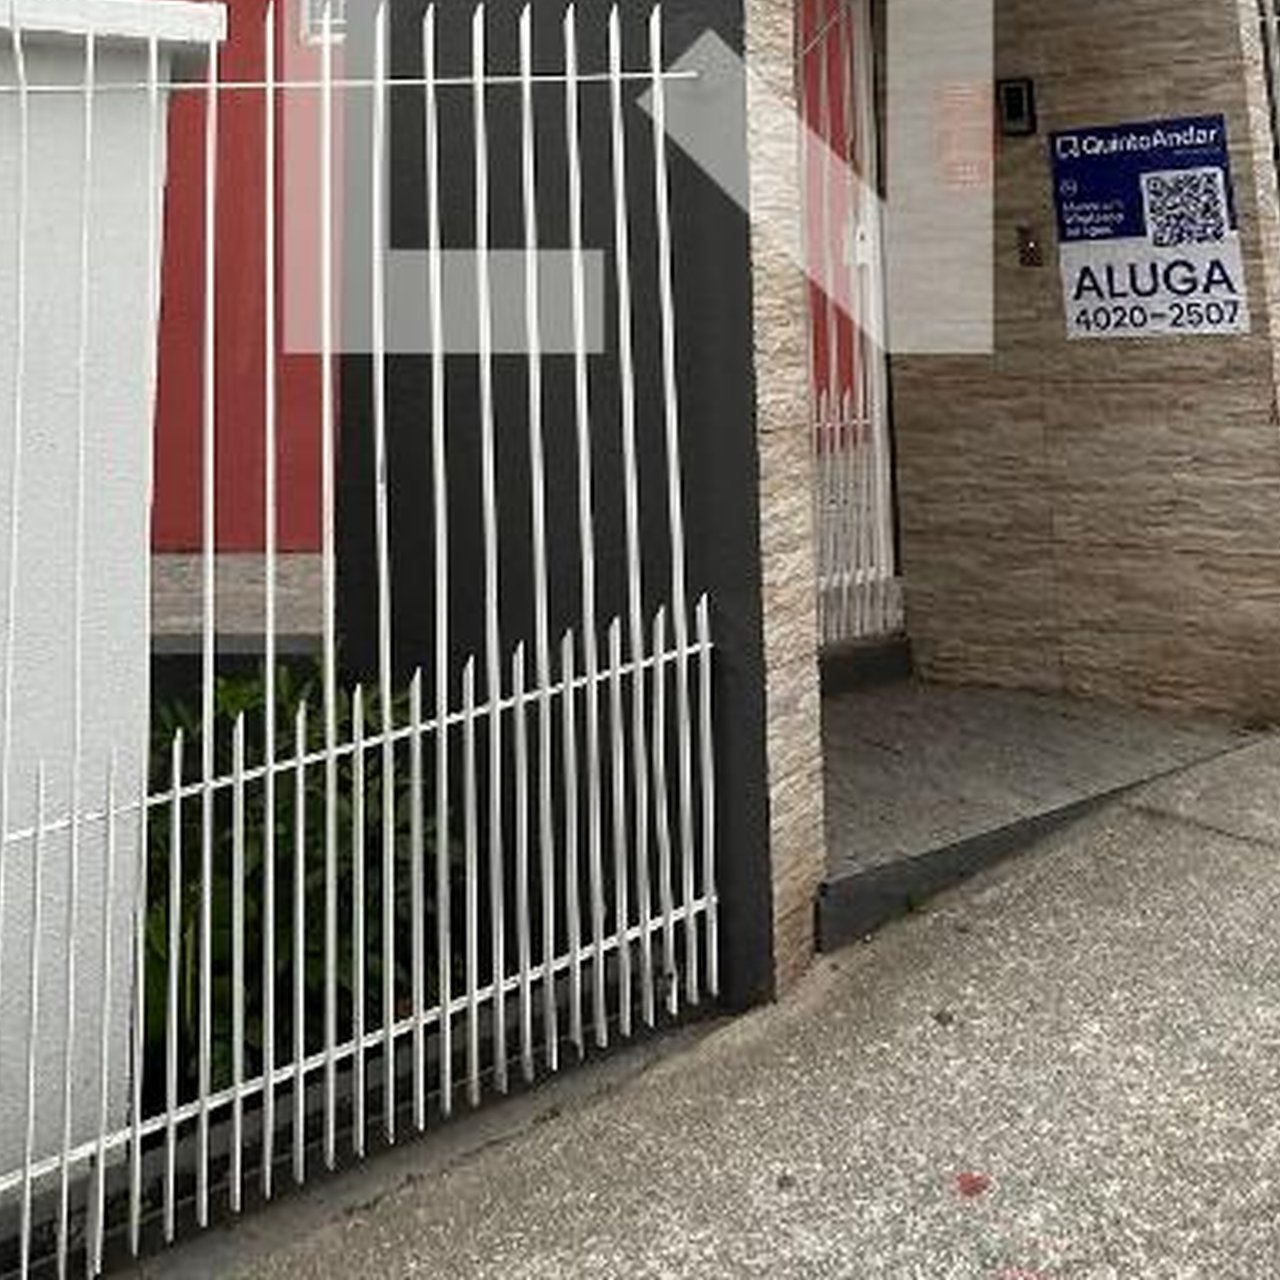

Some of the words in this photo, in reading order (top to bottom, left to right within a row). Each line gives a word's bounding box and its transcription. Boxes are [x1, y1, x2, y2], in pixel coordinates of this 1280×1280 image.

[1082, 126, 1218, 156] QuintoAndar
[1072, 259, 1237, 301] ALUGA
[1075, 301, 1238, 331] 4020-2507
